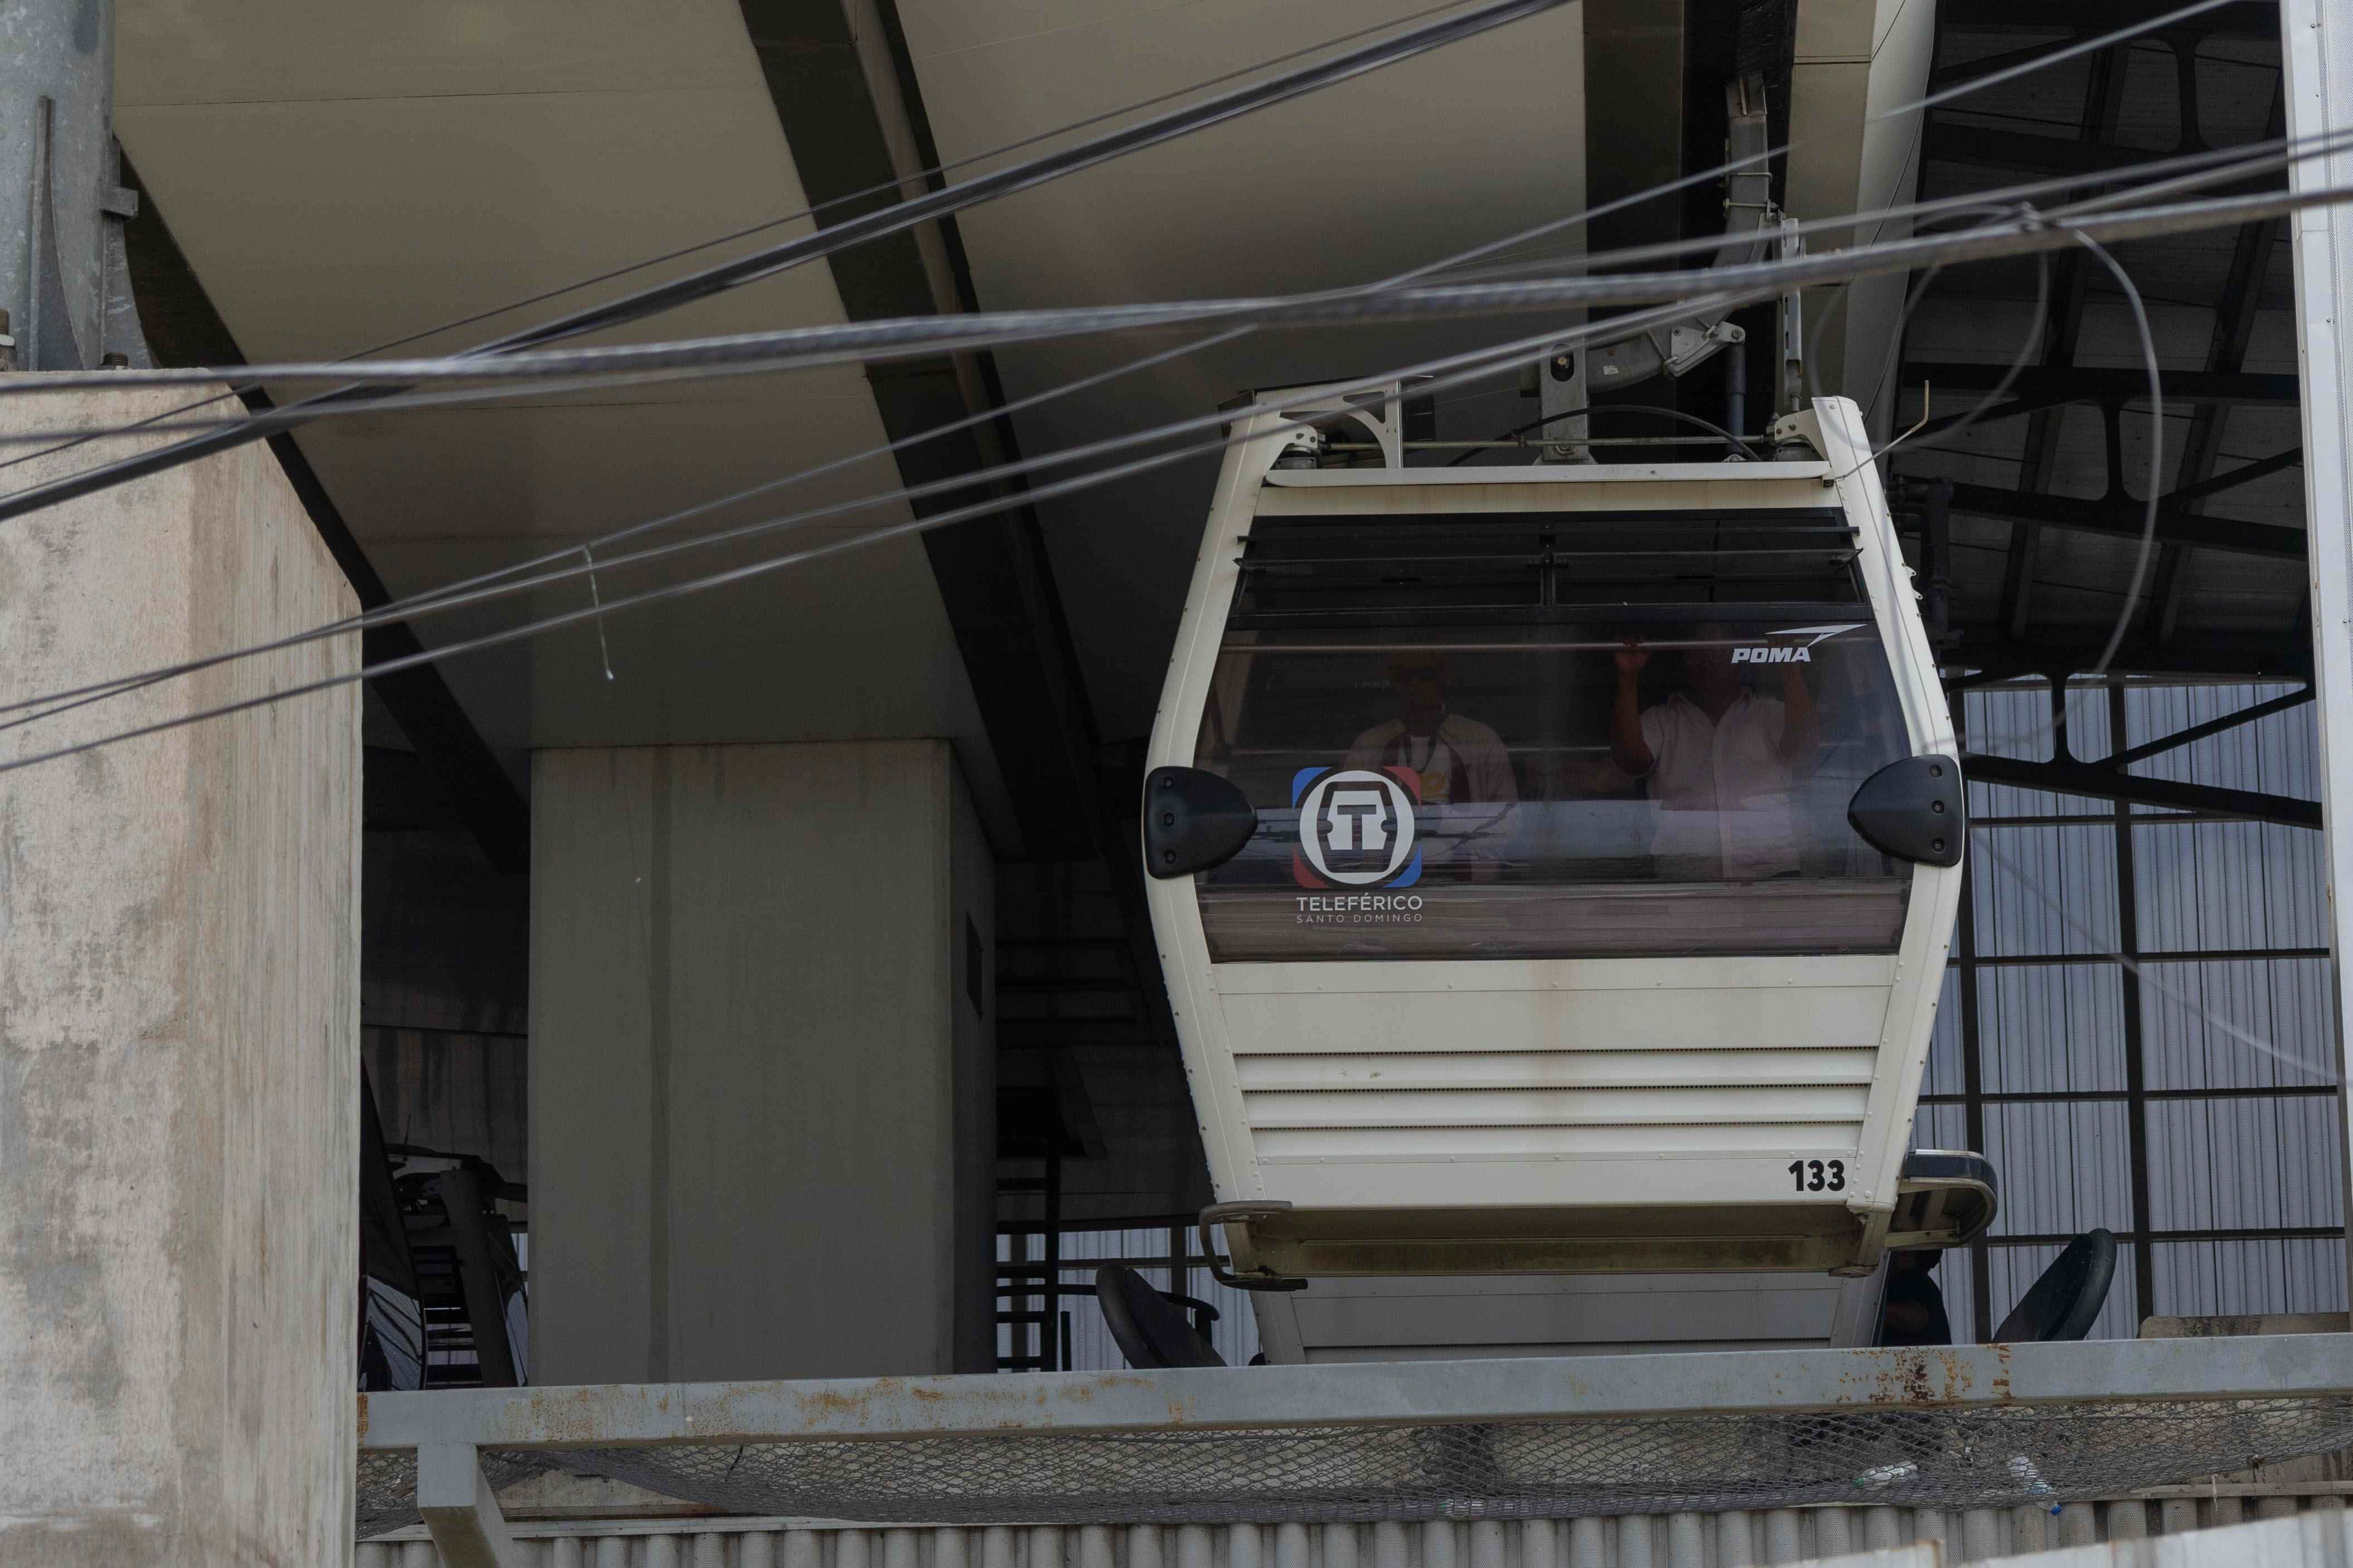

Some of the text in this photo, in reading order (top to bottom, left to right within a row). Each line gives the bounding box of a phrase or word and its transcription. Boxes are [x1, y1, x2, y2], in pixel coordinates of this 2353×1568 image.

[1731, 647, 1812, 664] POMA
[1296, 892, 1422, 911] TELEFÉRICO
[1296, 914, 1422, 924] SANTO DOMINGO
[1788, 1159, 1846, 1192] 133
